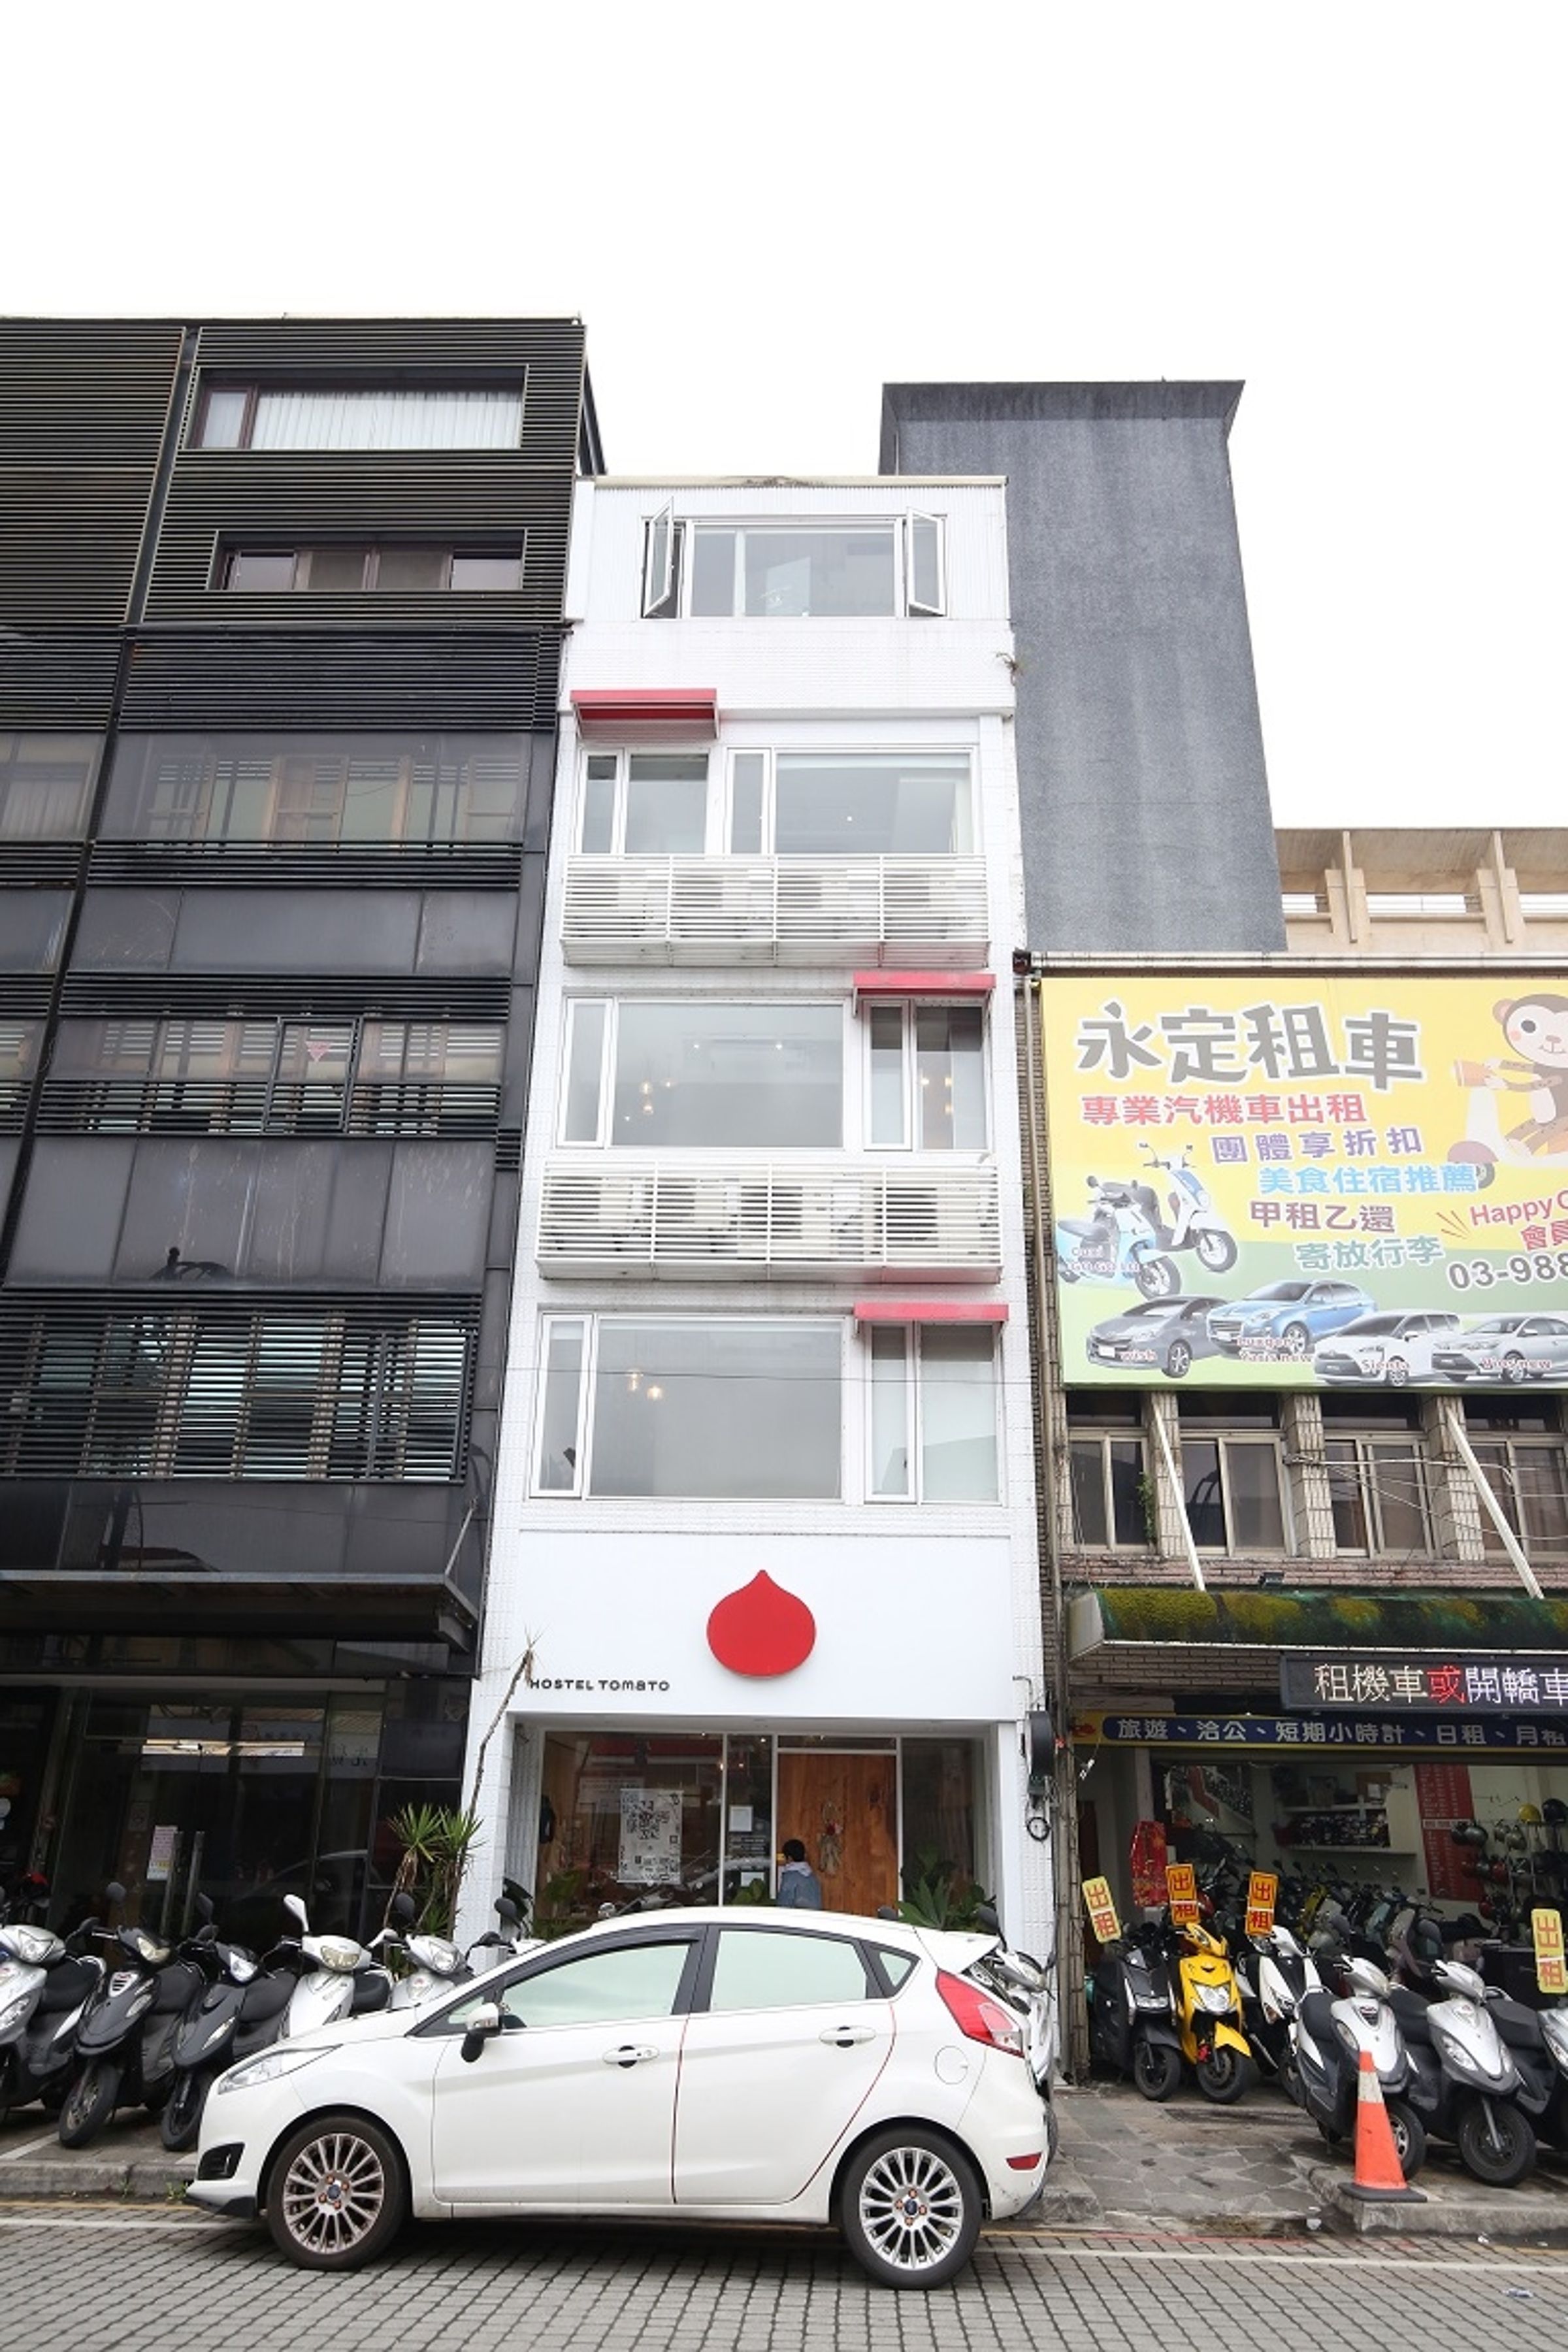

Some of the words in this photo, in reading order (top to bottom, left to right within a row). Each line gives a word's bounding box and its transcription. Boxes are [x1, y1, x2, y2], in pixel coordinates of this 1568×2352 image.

[1077, 1002, 1422, 1090] 永定租車
[1081, 1094, 1366, 1124] 專業汽機車出租
[1212, 1128, 1422, 1163] 團體享折扣
[1260, 1166, 1477, 1194] 美食住宿推薦
[1250, 1201, 1394, 1232] 甲租乙還
[1470, 1198, 1553, 1225] Happy
[1296, 1237, 1444, 1270] 寄放行李
[531, 1679, 593, 1690] HOSTEL
[1314, 1663, 1568, 1705] 租機車或開轎車
[1086, 1884, 1116, 1938] 出租
[1171, 1871, 1197, 1918] 出租
[1250, 1882, 1271, 1923] 出租
